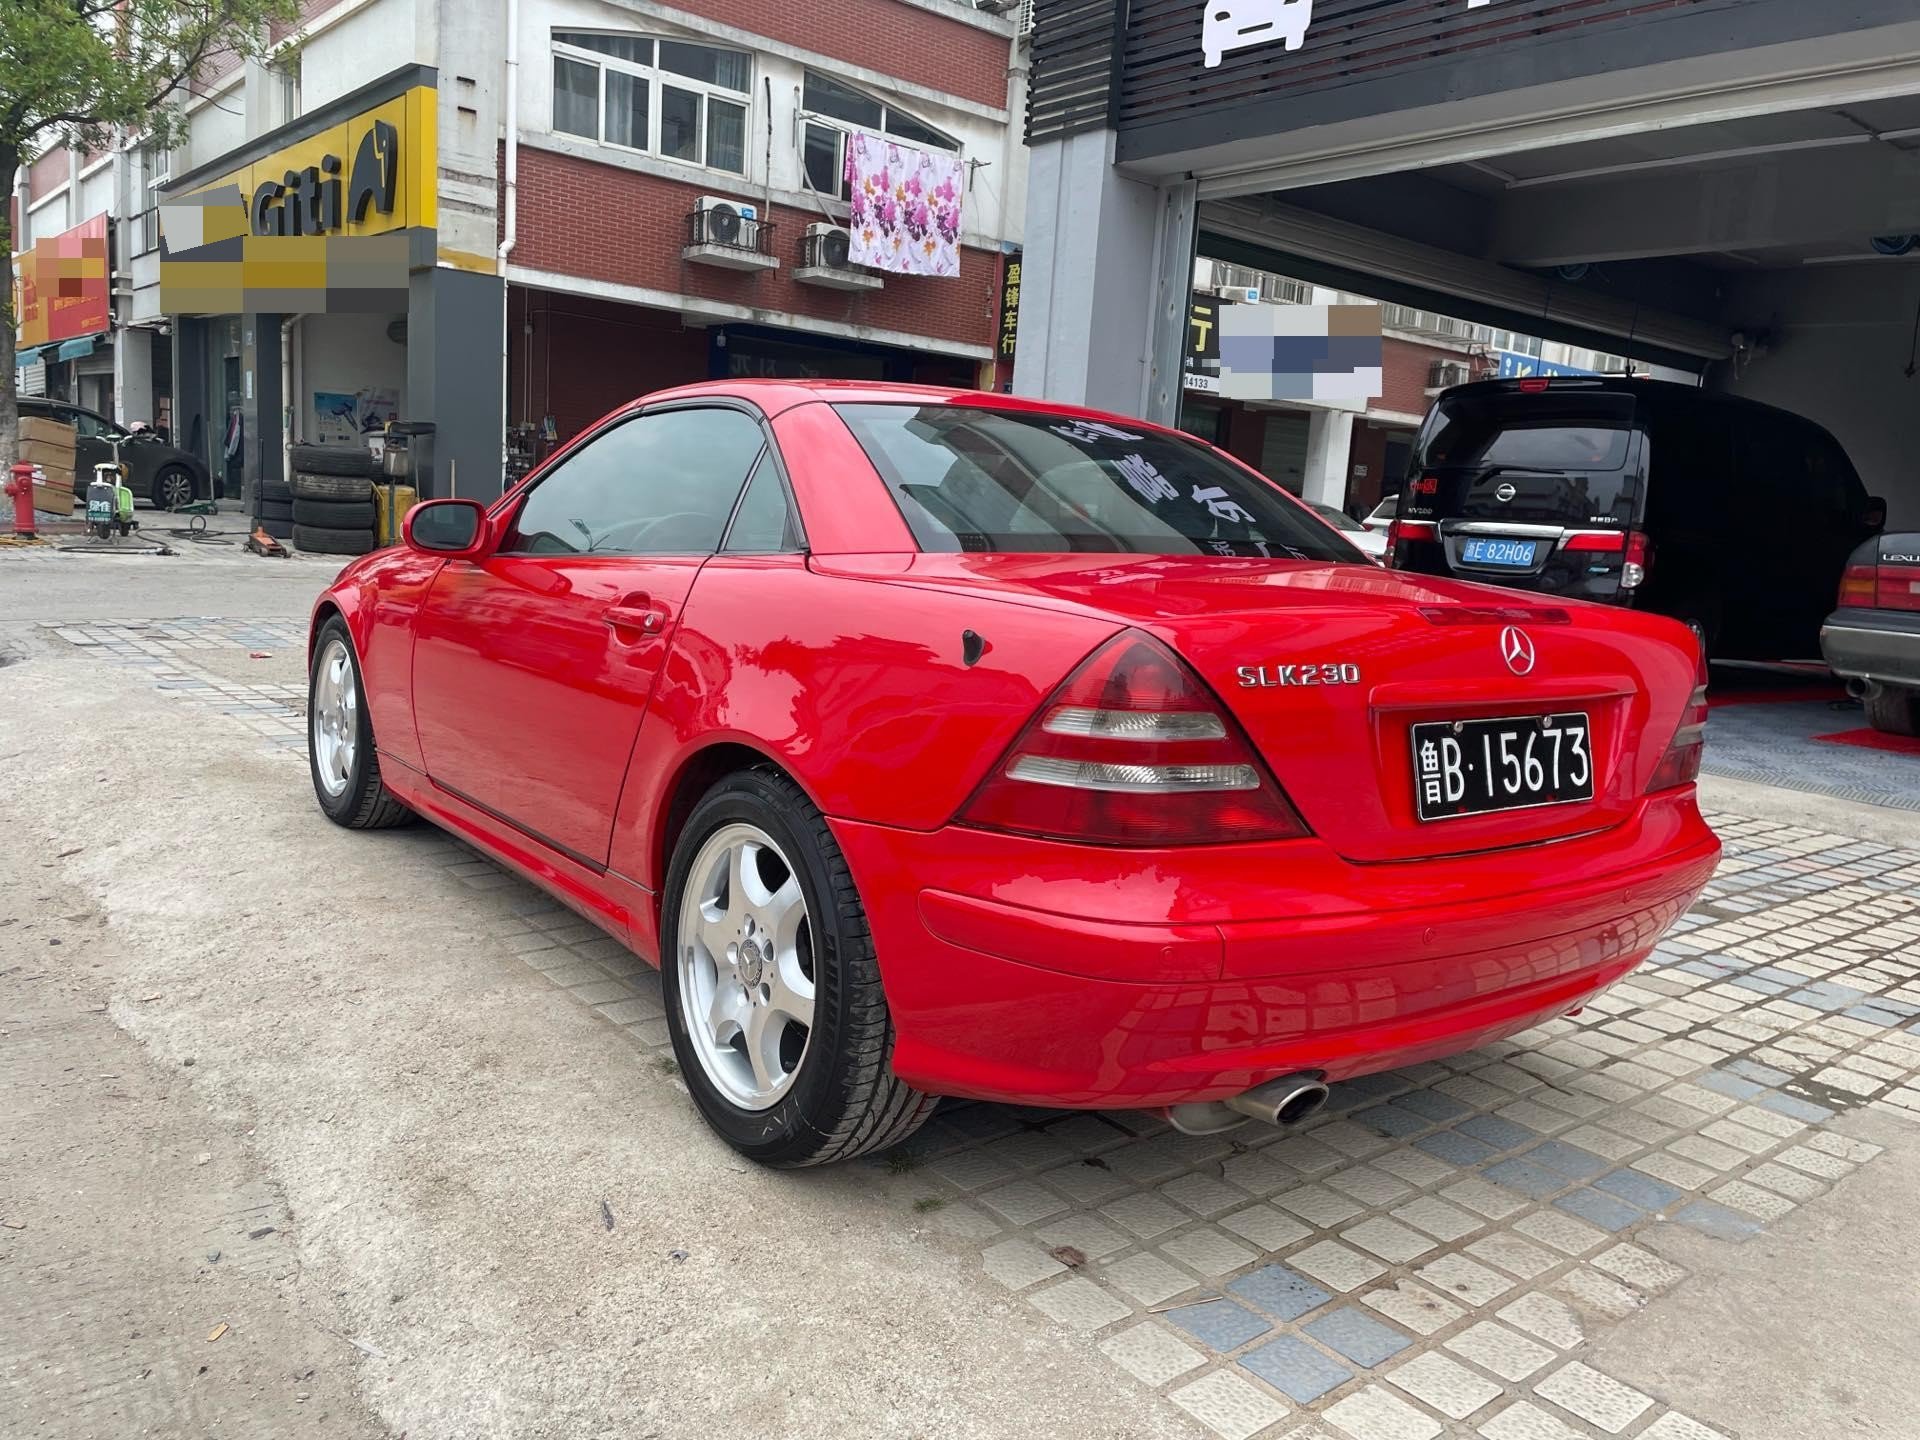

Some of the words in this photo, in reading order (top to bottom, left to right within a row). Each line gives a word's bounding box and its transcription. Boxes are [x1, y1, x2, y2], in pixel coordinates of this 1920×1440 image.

[251, 154, 341, 236] Giti
[1002, 263, 1021, 354] 盈锋车行
[1236, 662, 1361, 688] SLK230
